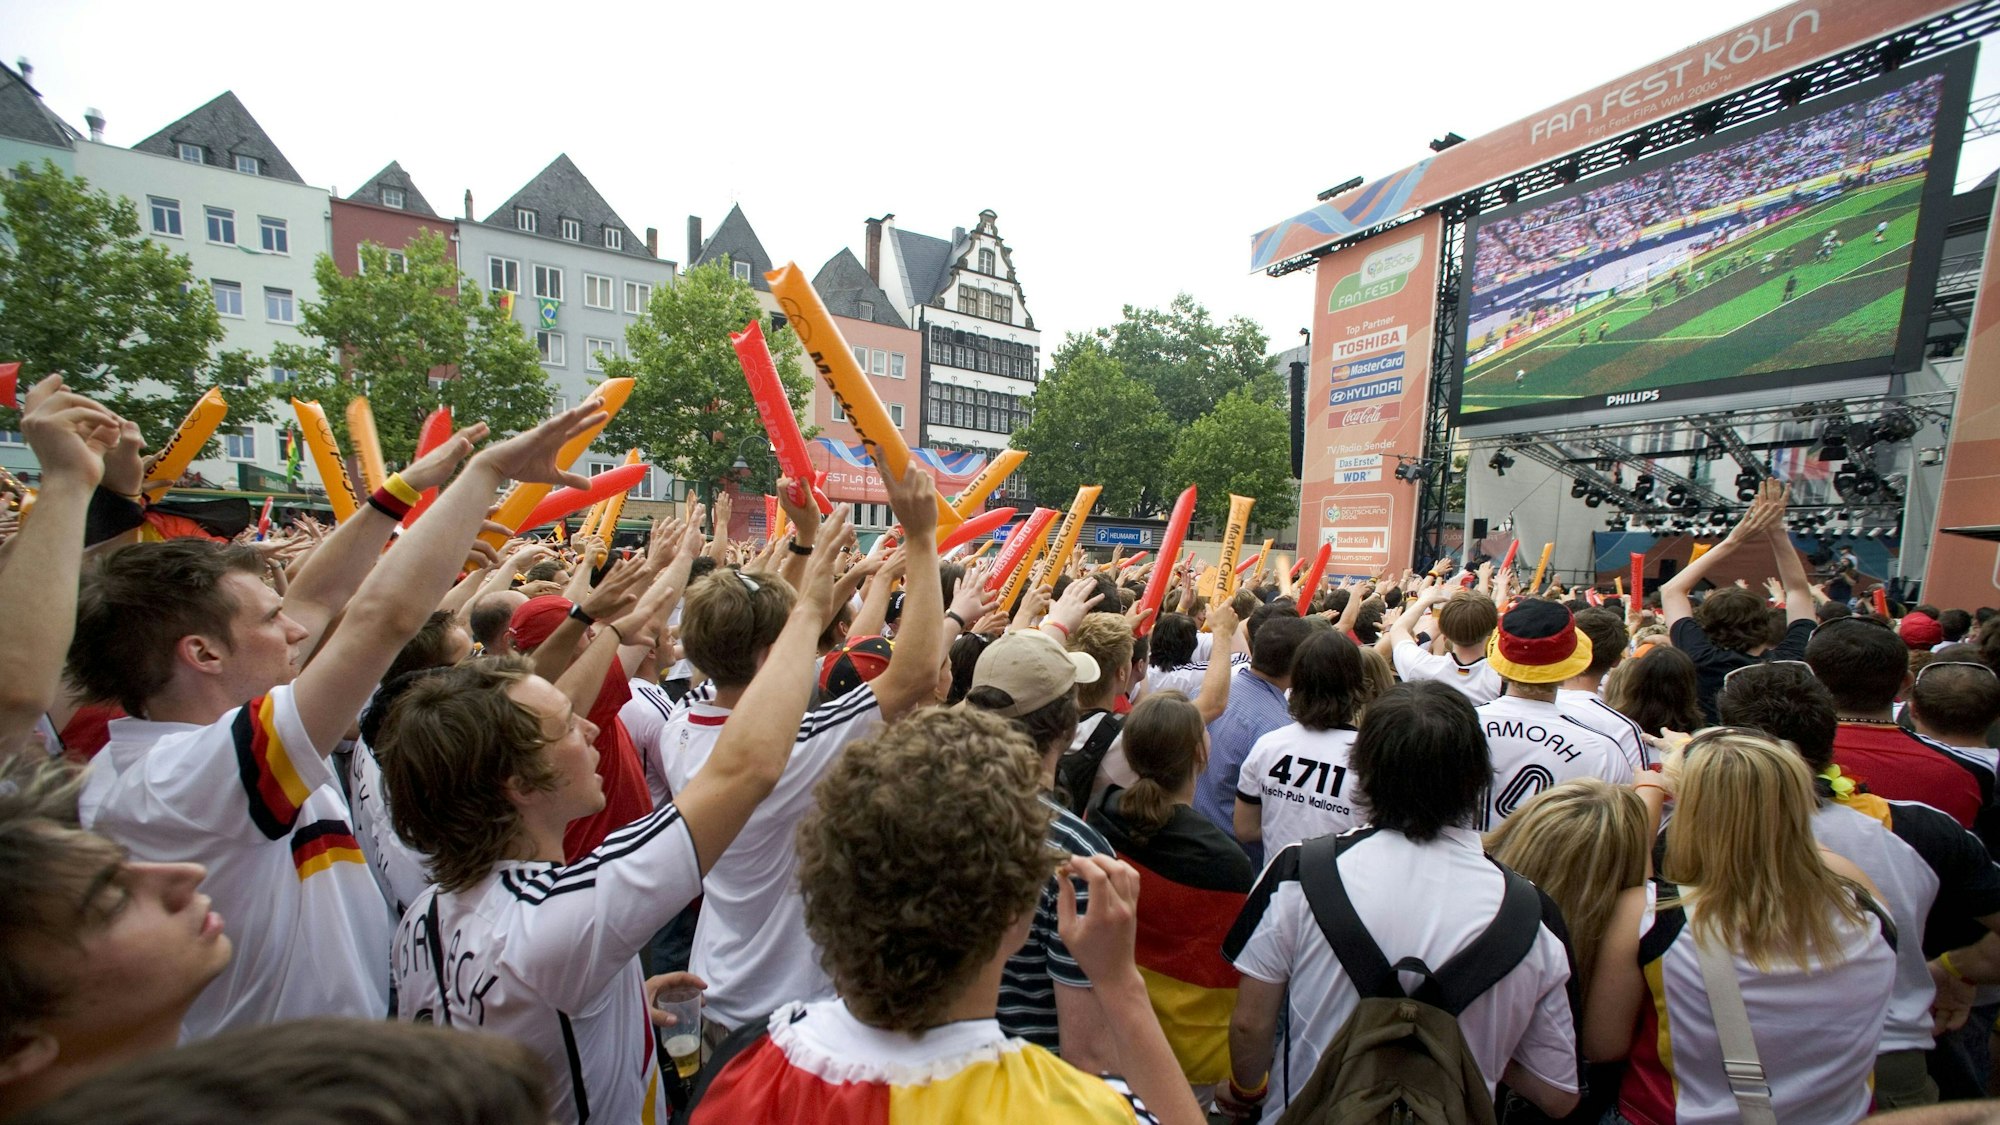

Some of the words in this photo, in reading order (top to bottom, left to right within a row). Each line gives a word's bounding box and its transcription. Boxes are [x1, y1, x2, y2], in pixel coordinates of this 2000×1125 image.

[1531, 103, 1592, 145] FAN
[1602, 59, 1693, 118] FEST
[1703, 9, 1820, 77] KÖLN
[1587, 125, 1606, 136] Fan
[1609, 115, 1631, 129] Fest
[1633, 104, 1658, 119] FIFA
[1661, 93, 1684, 108] WM
[1338, 291, 1361, 307] FAN
[1365, 280, 1396, 299] FEST
[1346, 325, 1360, 335] Top
[1362, 315, 1395, 331] Partner
[1338, 330, 1400, 356] TOSHIBA
[1350, 355, 1403, 376] MasterCard
[1347, 380, 1401, 400] HYUNDAI
[1606, 389, 1660, 406] PHILIPS
[1327, 443, 1362, 454] TV/Radio
[1364, 439, 1396, 450] Sender
[1340, 460, 1352, 468] Das
[850, 474, 863, 484] LA
[1344, 471, 1366, 482] WDR
[1045, 511, 1077, 577] MasterCard
[1109, 532, 1139, 540] HEUMARKT
[1338, 536, 1353, 544] Stadt
[1354, 536, 1369, 544] Köln
[992, 525, 1032, 579] MasterCard
[1217, 523, 1241, 592] MasterCard
[1487, 721, 1581, 763] AMOAH
[1268, 754, 1347, 798] 4711
[1309, 795, 1350, 815] Mallorca
[403, 913, 499, 1026] BAACK
